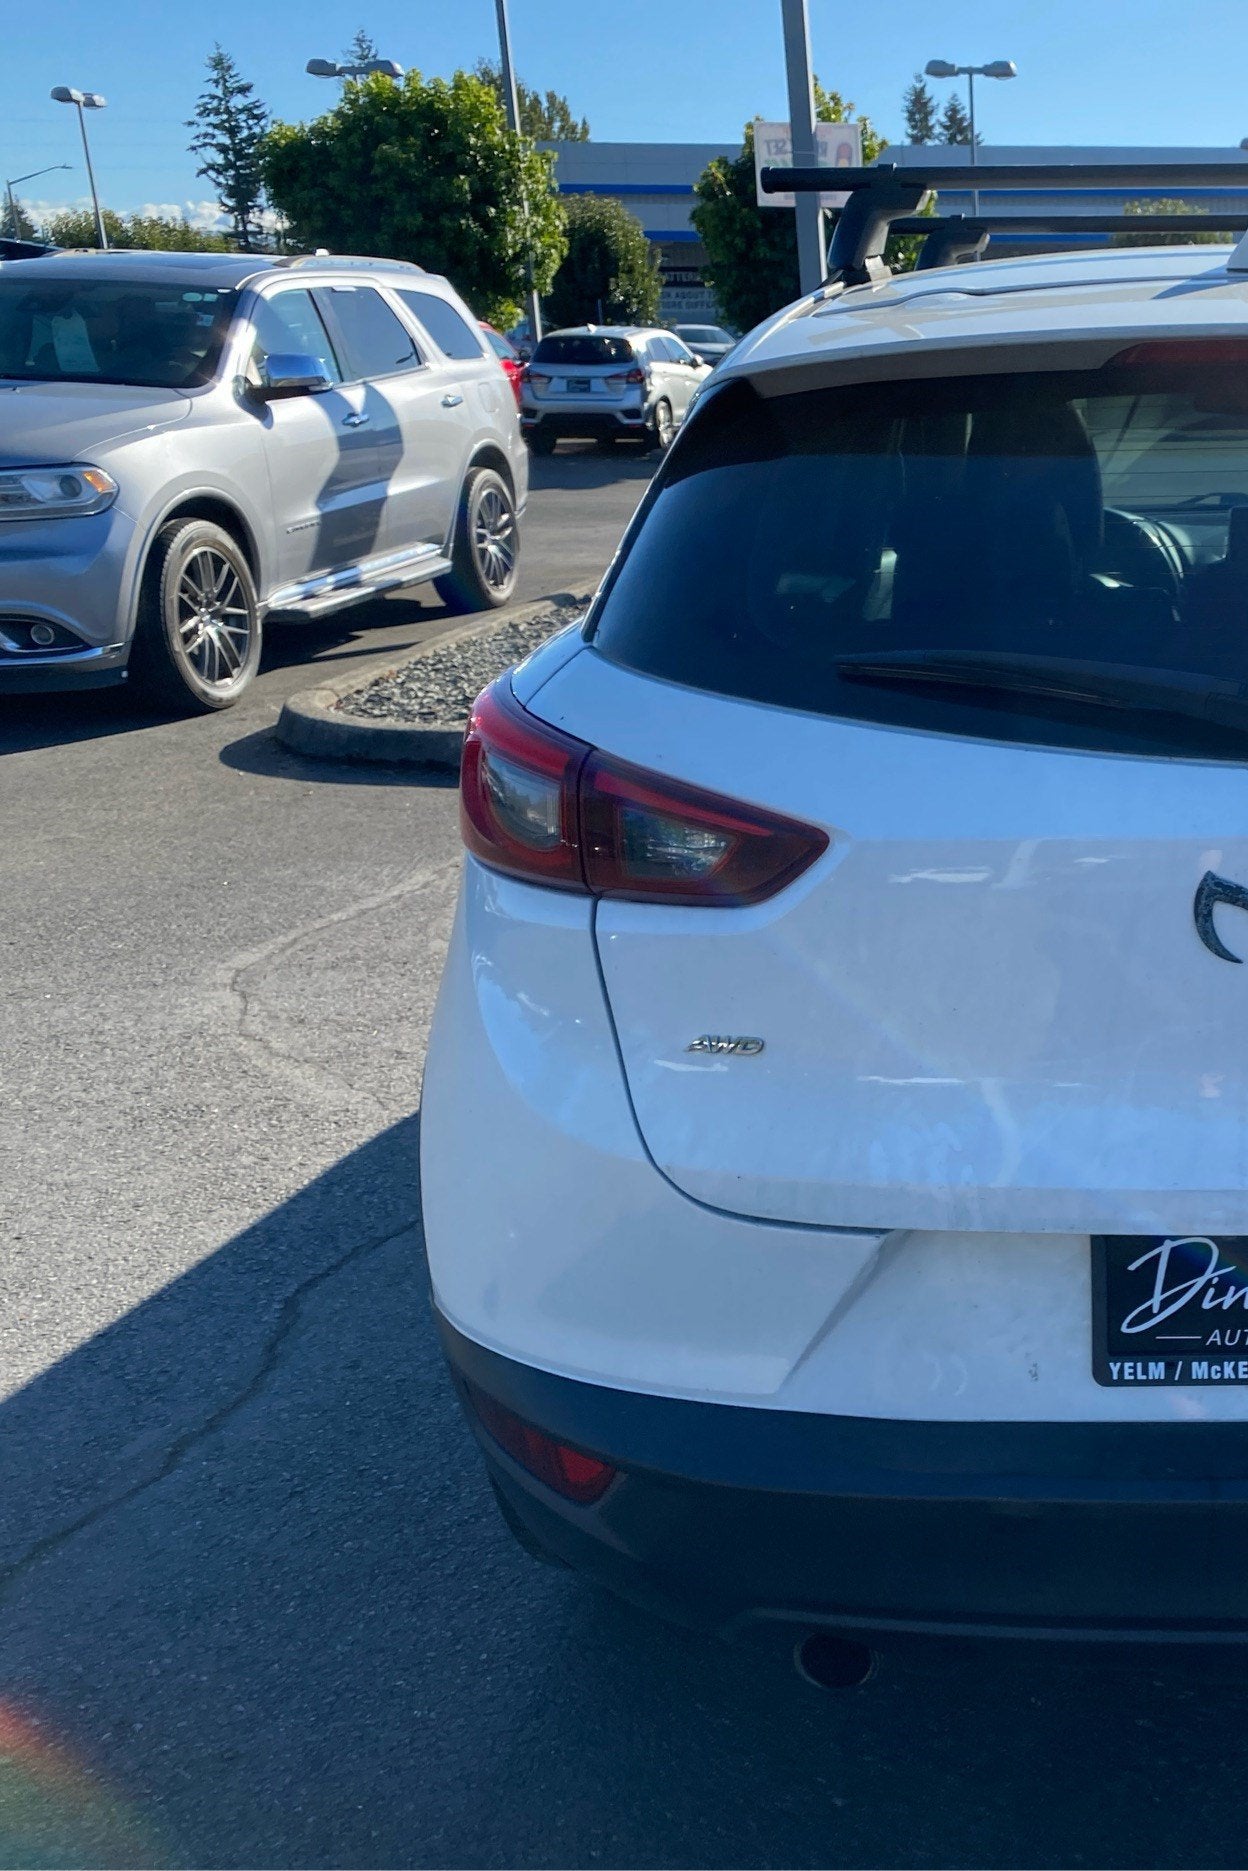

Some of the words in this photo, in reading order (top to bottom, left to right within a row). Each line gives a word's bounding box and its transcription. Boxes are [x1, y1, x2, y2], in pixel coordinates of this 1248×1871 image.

[685, 1034, 765, 1056] AWD
[1109, 1362, 1165, 1380] YELM
[1174, 1361, 1183, 1381] /
